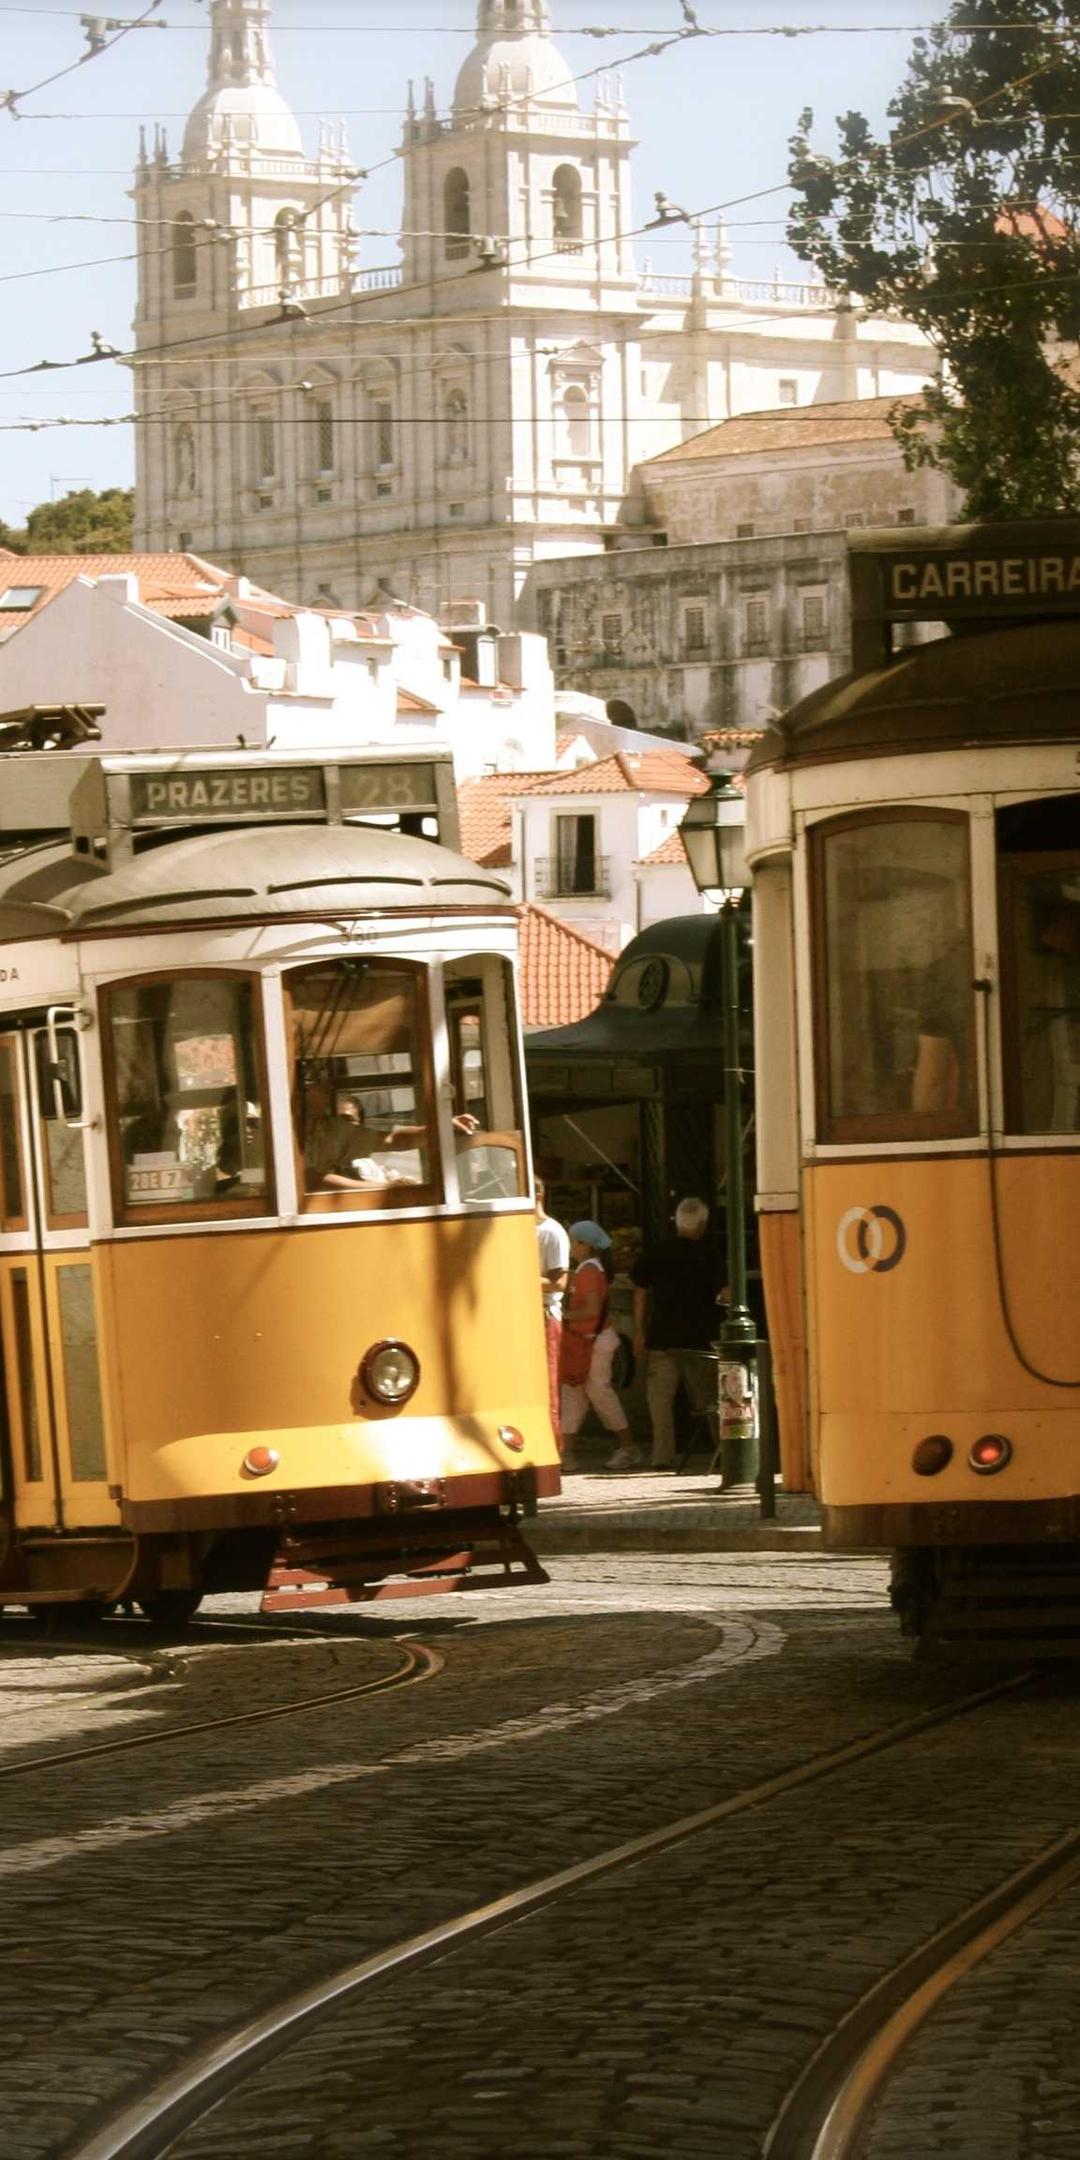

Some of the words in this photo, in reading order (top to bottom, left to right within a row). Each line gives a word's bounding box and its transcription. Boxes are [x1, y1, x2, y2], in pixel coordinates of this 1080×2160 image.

[147, 775, 310, 810] PRAZERES
[358, 772, 415, 808] 28
[131, 1172, 159, 1190] 28E
